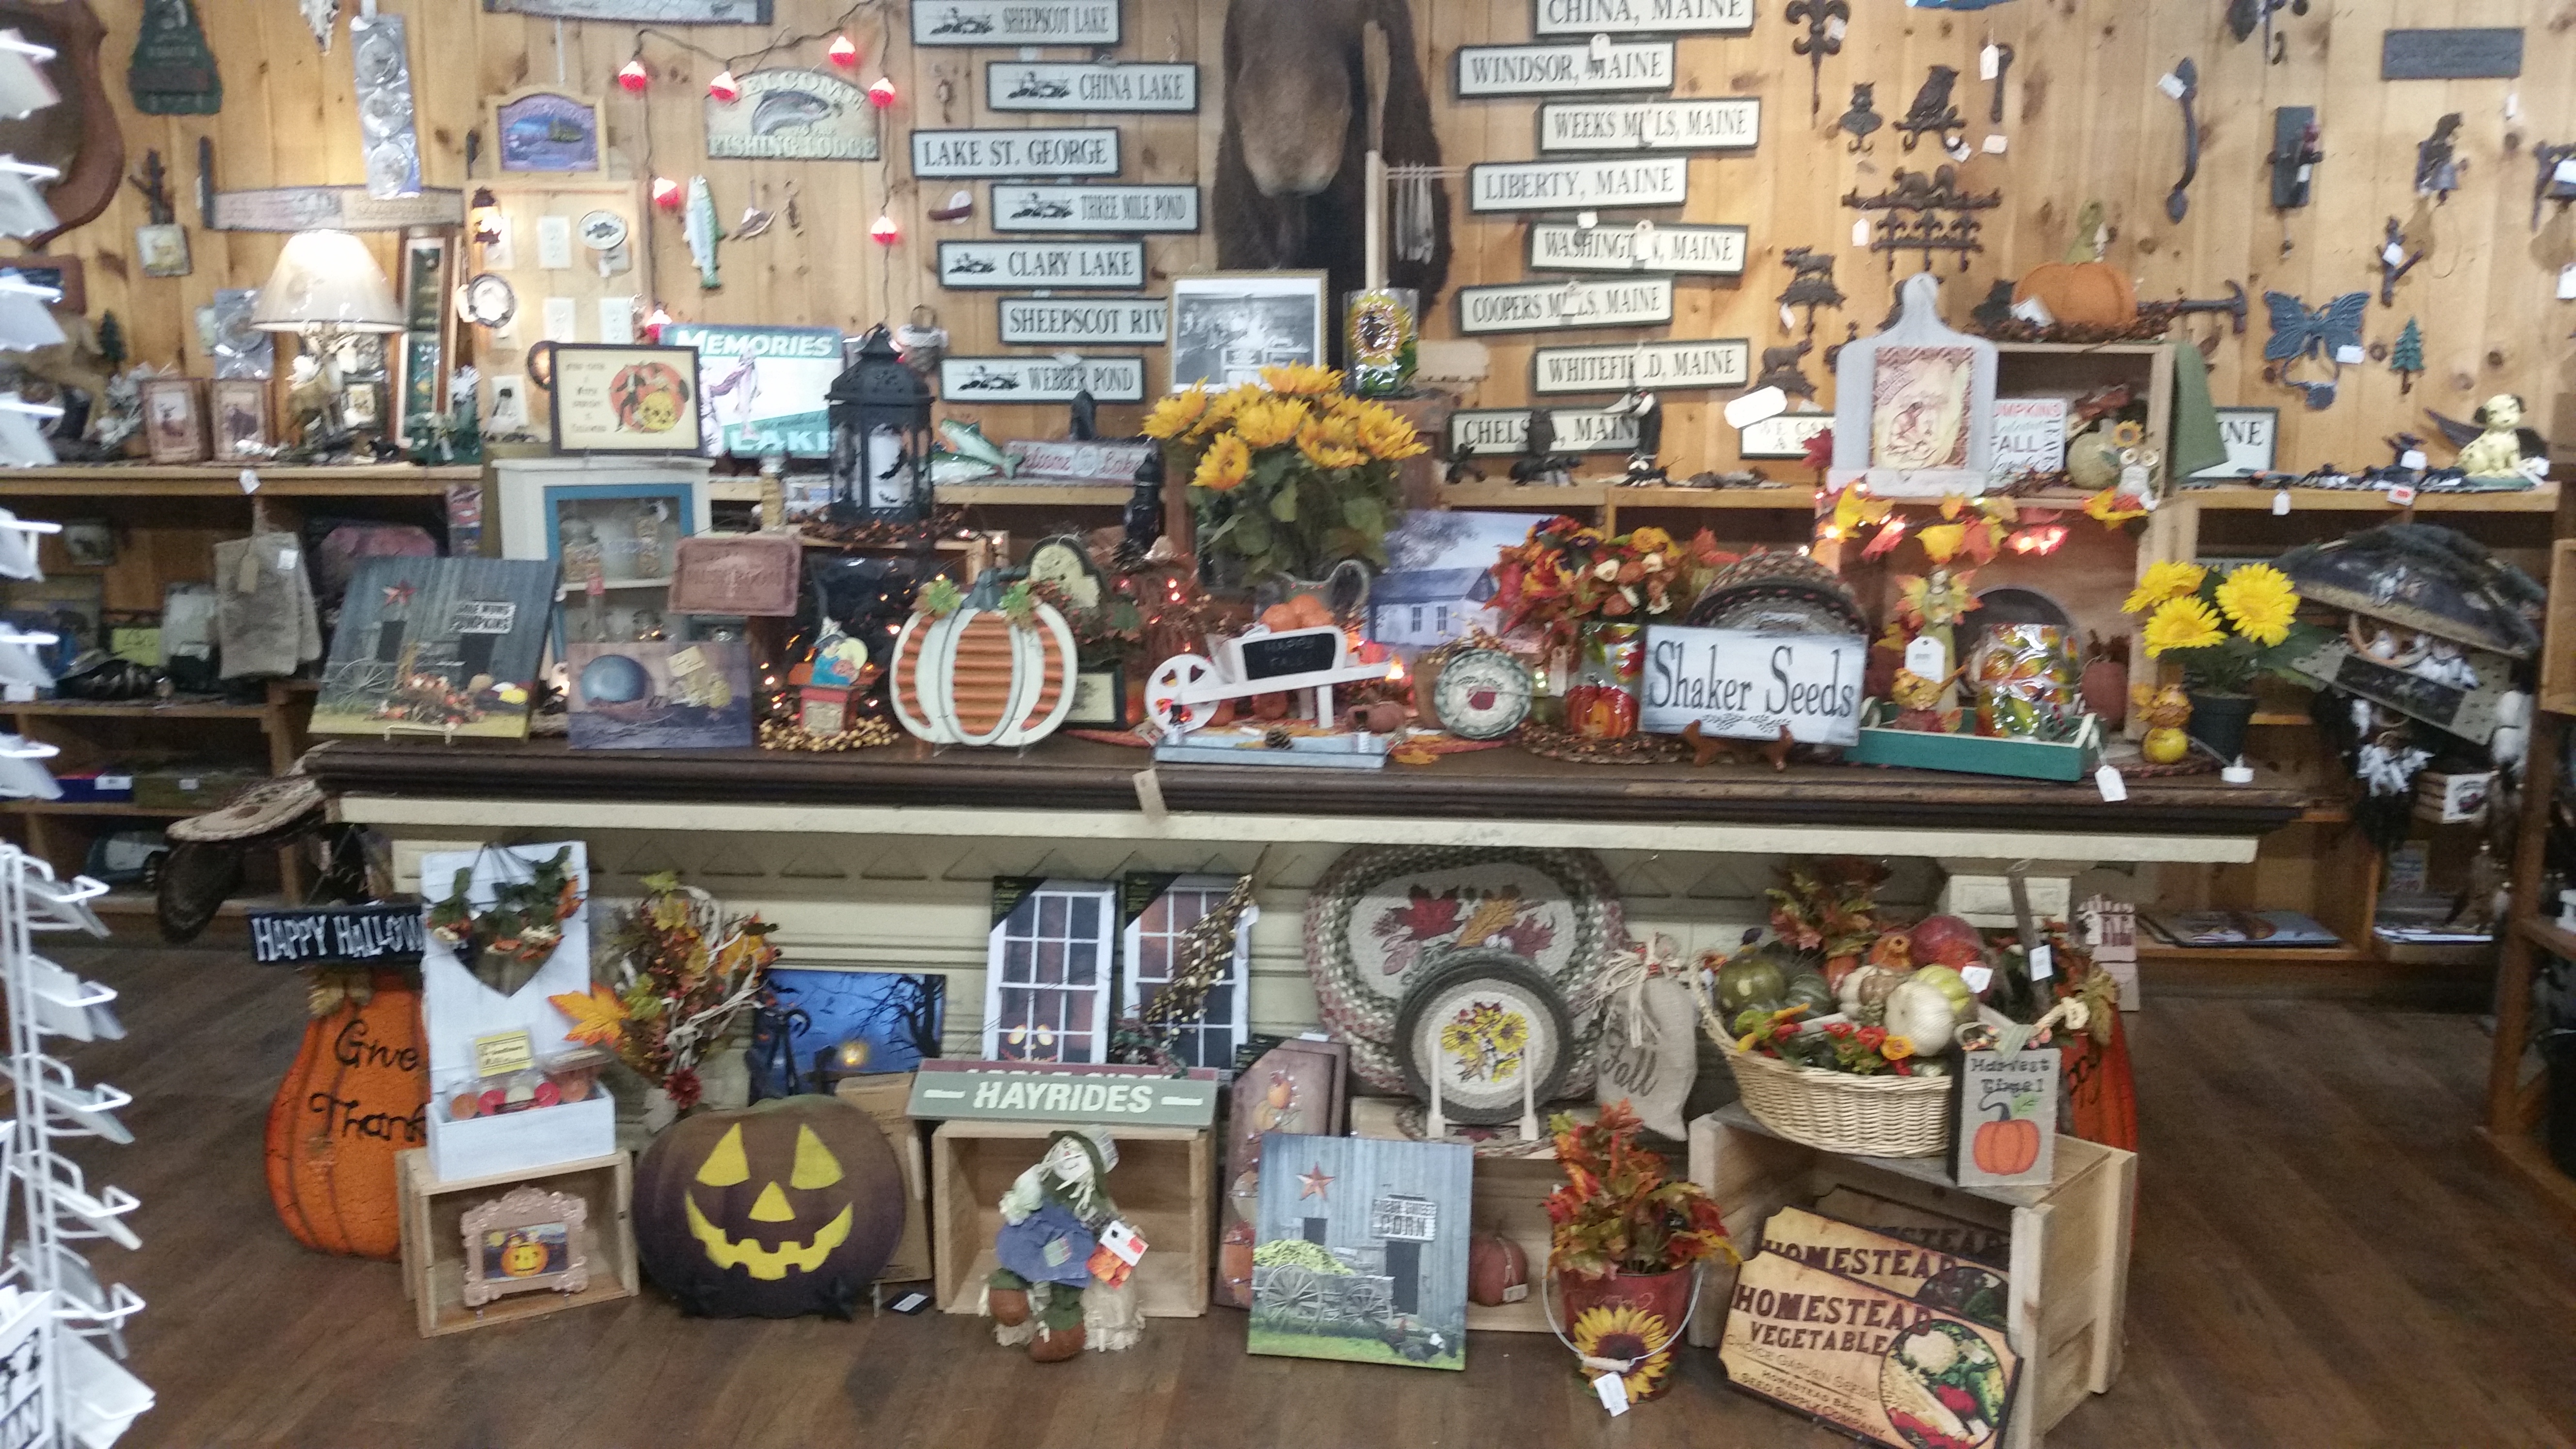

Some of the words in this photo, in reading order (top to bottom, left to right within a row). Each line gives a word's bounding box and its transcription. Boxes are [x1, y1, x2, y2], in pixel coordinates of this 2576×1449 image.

[1074, 6, 1110, 33] LAKE
[1548, 0, 1639, 27] CHINA,
[1651, 0, 1744, 19] MAINE
[1471, 54, 1579, 86] WINDSOR,
[730, 71, 868, 112] ELCOME
[1079, 73, 1132, 101] CHINA
[1138, 73, 1185, 101] LAKE
[1554, 111, 1616, 138] WEEKS
[1686, 108, 1748, 136] MAINE
[709, 135, 800, 157] FISHING
[804, 136, 878, 158] LODGE
[923, 140, 982, 167] LAKE
[989, 140, 1020, 167] ST.
[1028, 138, 1108, 166] GEORGE
[1484, 171, 1585, 201] LIBERTY,
[1595, 166, 1674, 195] MAINE
[1080, 194, 1117, 221] THREE
[1153, 194, 1187, 221] POND
[1671, 234, 1735, 261] MAINE
[1007, 251, 1071, 276] CLARY
[1079, 251, 1134, 276] LAKE
[1472, 294, 1542, 322] COOPERS
[1606, 286, 1662, 314] MAINE
[1009, 307, 1123, 334] SHEEPSCOT
[1129, 307, 1167, 334] RIV
[675, 329, 834, 357] MEMORIES
[1673, 349, 1736, 377] MAINE
[1027, 366, 1088, 391] WEBBER
[1094, 366, 1135, 392] POND
[1573, 415, 1640, 442] MAIN
[1651, 639, 1754, 713] Shaker
[1765, 644, 1855, 718] Seeds
[251, 914, 327, 962] HAPPY
[335, 1018, 420, 1072] Give
[972, 1081, 1154, 1114] HAYRIDES
[308, 1091, 426, 1143] Thank
[1733, 1284, 1932, 1336] HOMESTEAD
